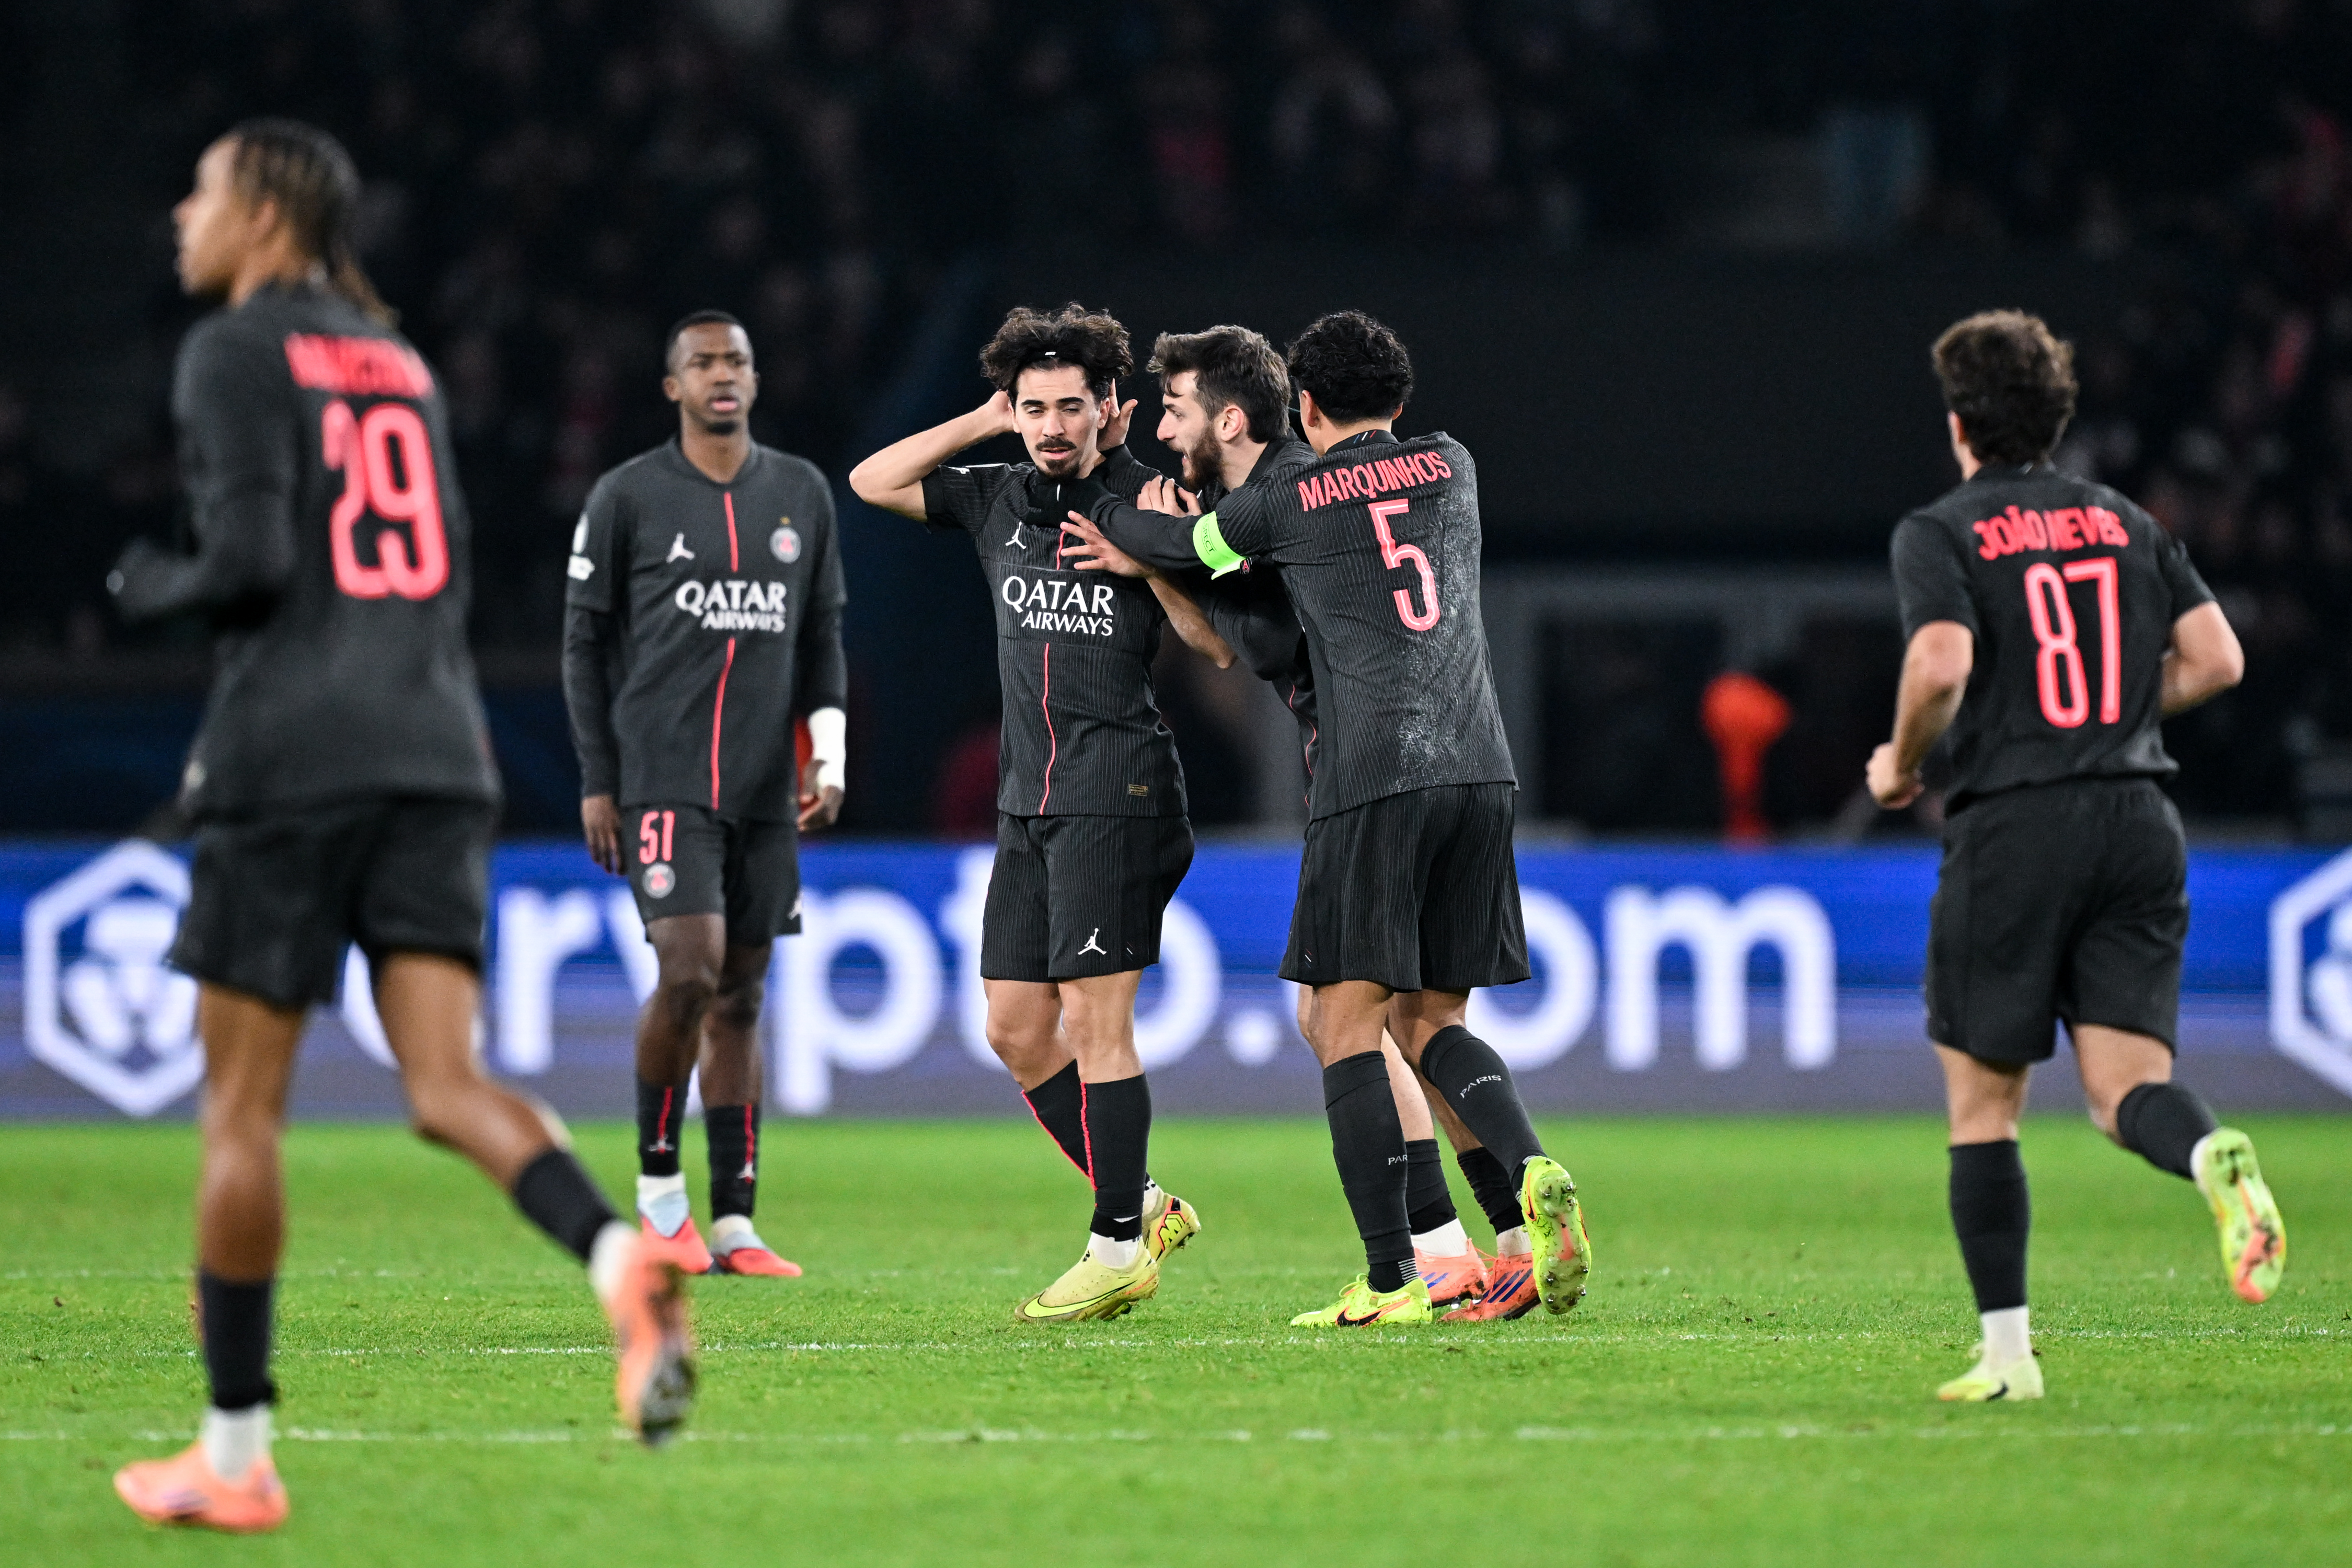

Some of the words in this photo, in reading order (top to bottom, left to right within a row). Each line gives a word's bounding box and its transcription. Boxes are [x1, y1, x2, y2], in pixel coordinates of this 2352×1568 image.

[321, 399, 450, 602] 29
[1297, 452, 1452, 512] MARQUINHOS
[1202, 514, 1215, 552] ESPECT
[2043, 505, 2130, 552] NEVES
[1367, 498, 1440, 631] 5
[675, 580, 787, 617] QATAR
[1002, 575, 1114, 616] QATAR
[1021, 612, 1113, 637] AIRWAYS
[2024, 556, 2121, 729] 87
[639, 810, 675, 864] 51
[340, 843, 1838, 1116] rpto.om
[1460, 1075, 1502, 1099] PARIS
